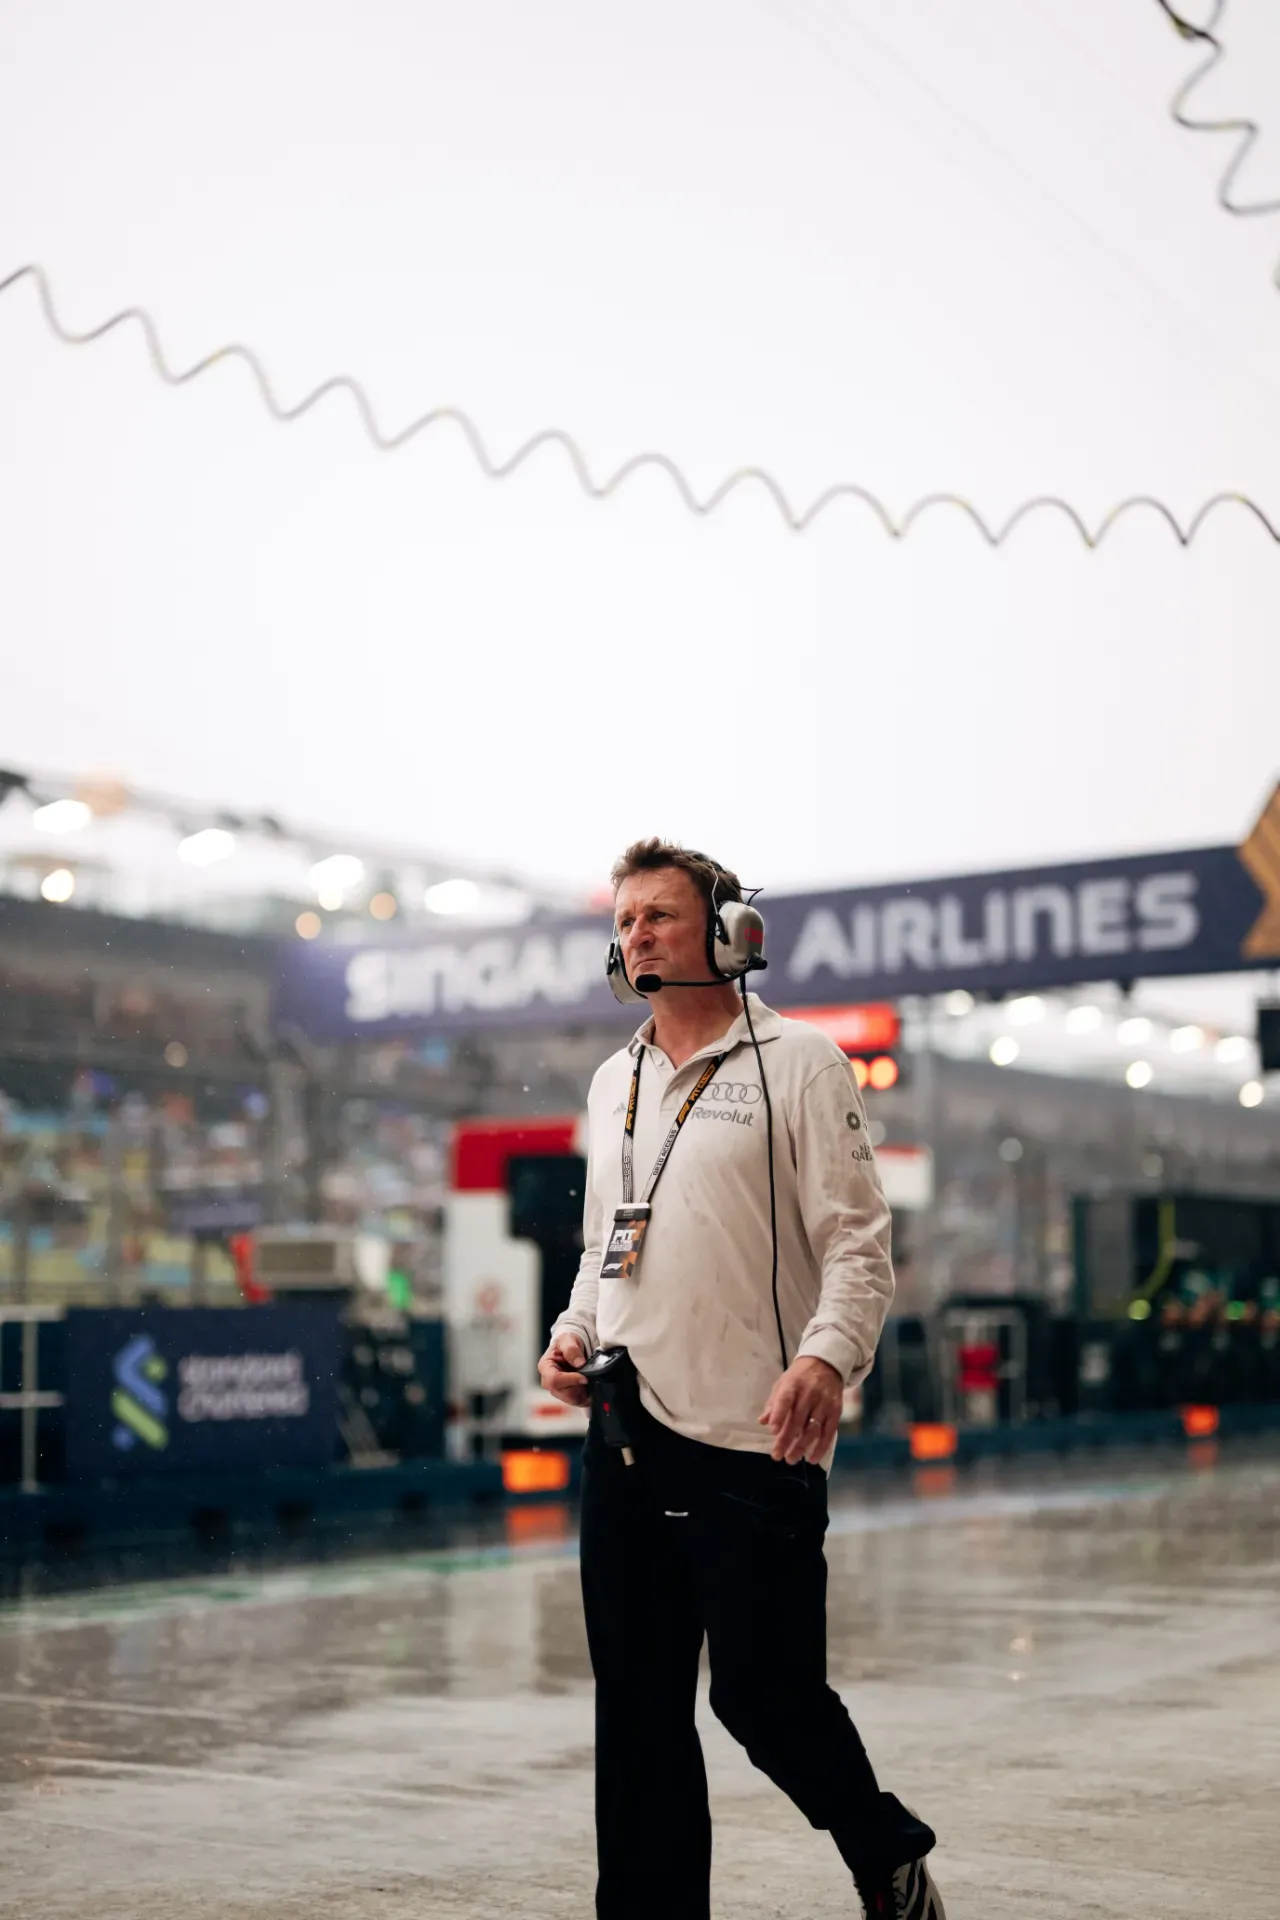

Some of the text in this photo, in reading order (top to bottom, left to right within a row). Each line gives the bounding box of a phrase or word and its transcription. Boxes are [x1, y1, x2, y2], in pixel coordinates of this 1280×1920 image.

[787, 872, 1197, 980] AIRLINES
[691, 1106, 754, 1127] Revolut
[653, 1129, 677, 1176] GRID ACCESS
